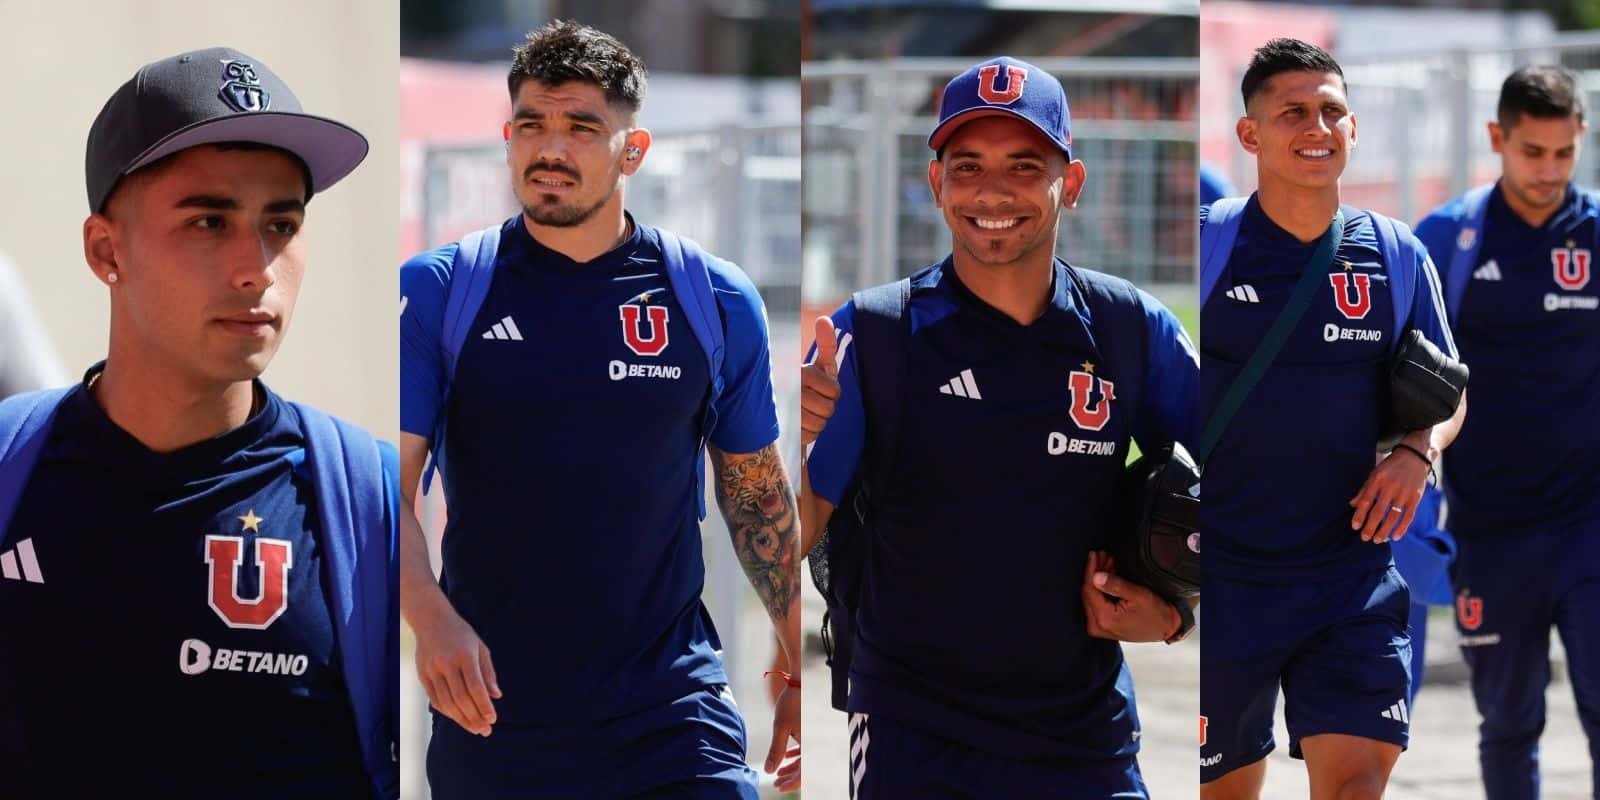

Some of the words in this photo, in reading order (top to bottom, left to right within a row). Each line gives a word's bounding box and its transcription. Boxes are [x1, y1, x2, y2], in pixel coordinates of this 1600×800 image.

[235, 87, 262, 111] U
[977, 65, 1027, 105] U
[1552, 248, 1591, 290] U
[1329, 274, 1371, 319] U
[619, 304, 669, 356] U
[1340, 328, 1381, 342] BETANO
[628, 365, 681, 380] BETANO
[1069, 371, 1115, 431] U
[1067, 439, 1115, 456] BETANO
[204, 534, 292, 630] U
[213, 649, 308, 675] BETANO
